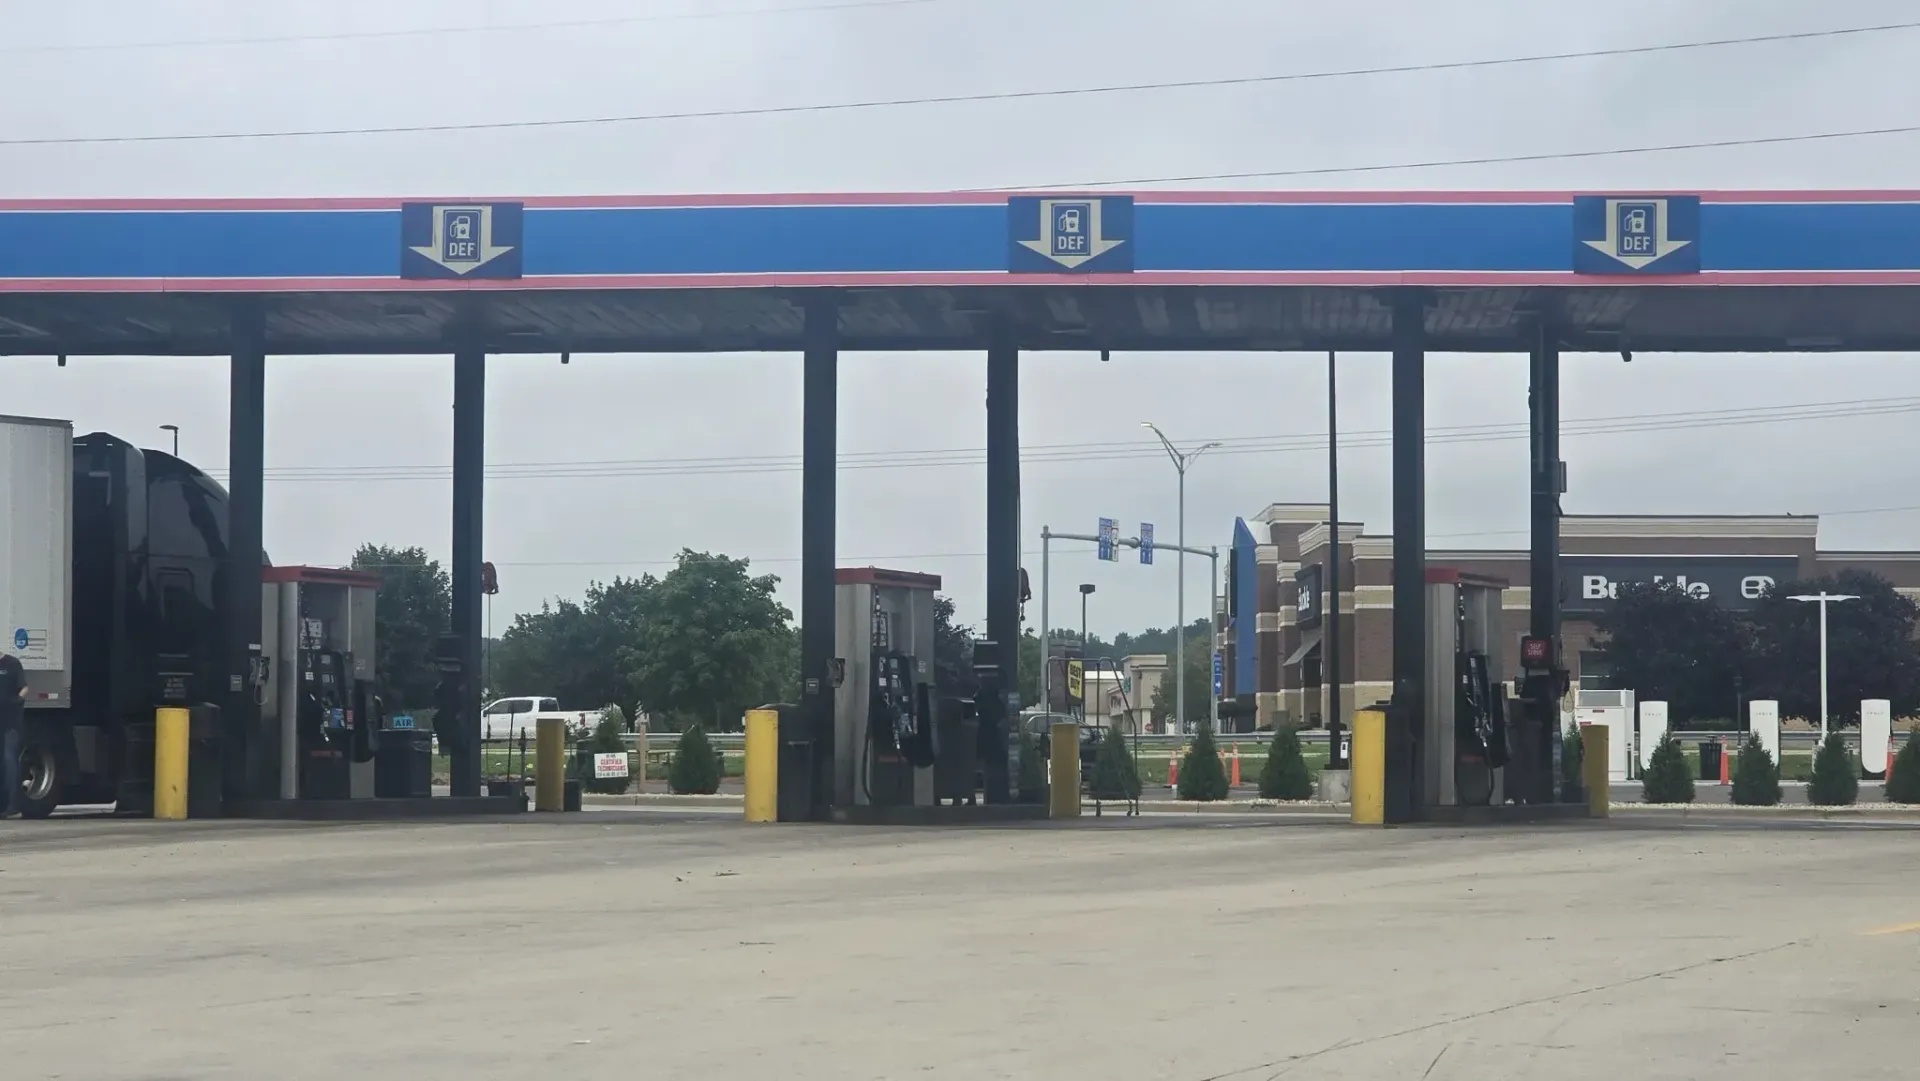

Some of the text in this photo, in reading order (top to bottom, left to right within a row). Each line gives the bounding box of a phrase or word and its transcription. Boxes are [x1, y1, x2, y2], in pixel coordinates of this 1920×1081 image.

[449, 242, 475, 256] DEF
[1058, 236, 1084, 249] DEF
[1624, 236, 1650, 250] DEF
[1583, 575, 1710, 599] Bule
[1069, 663, 1081, 679] BEST
[1070, 676, 1081, 689] BUY
[396, 718, 412, 727] AIR
